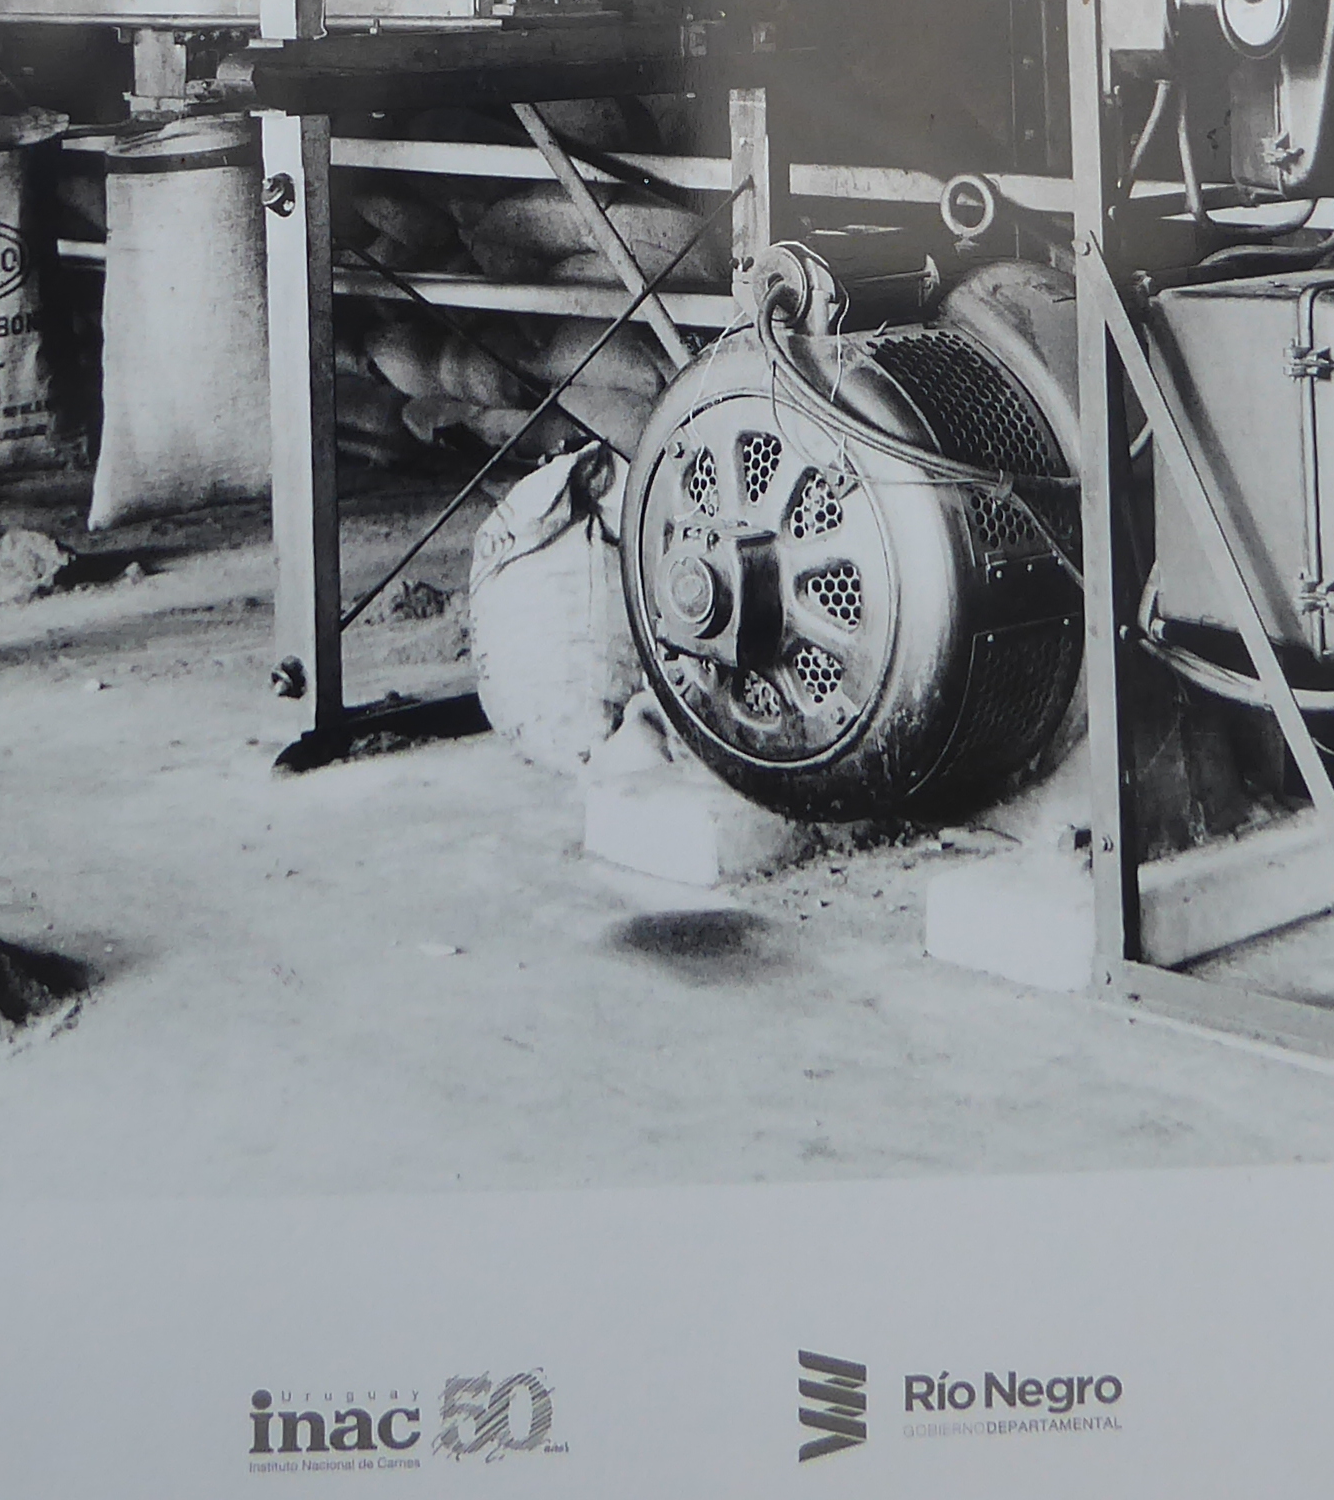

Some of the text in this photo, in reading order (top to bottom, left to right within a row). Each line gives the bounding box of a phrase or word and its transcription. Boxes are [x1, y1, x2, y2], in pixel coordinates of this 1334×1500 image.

[280, 1389, 420, 1403] Uruguay
[903, 1370, 1124, 1414] Río Negro
[249, 1367, 555, 1462] inac 50
[248, 1459, 299, 1474] Instituto
[301, 1458, 356, 1473] Nacional
[358, 1457, 376, 1471] de
